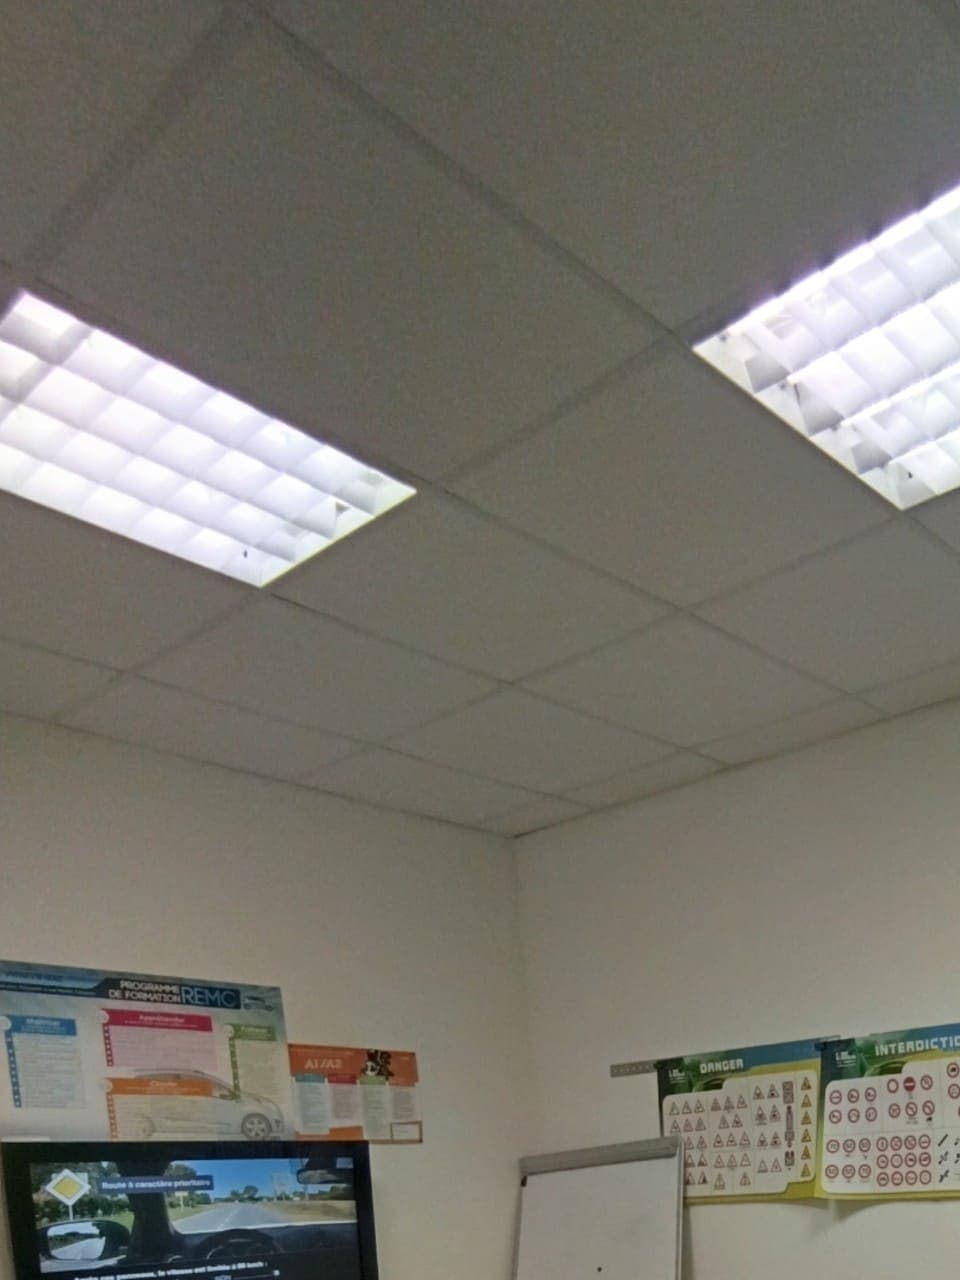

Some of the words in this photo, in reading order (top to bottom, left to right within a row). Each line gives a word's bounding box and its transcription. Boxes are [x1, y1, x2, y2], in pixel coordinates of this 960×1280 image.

[120, 980, 180, 994] PROGRAMME
[109, 989, 121, 999] DE
[125, 990, 181, 1003] FORMATION
[181, 986, 236, 1007] REMC
[699, 1058, 744, 1074] DANGER
